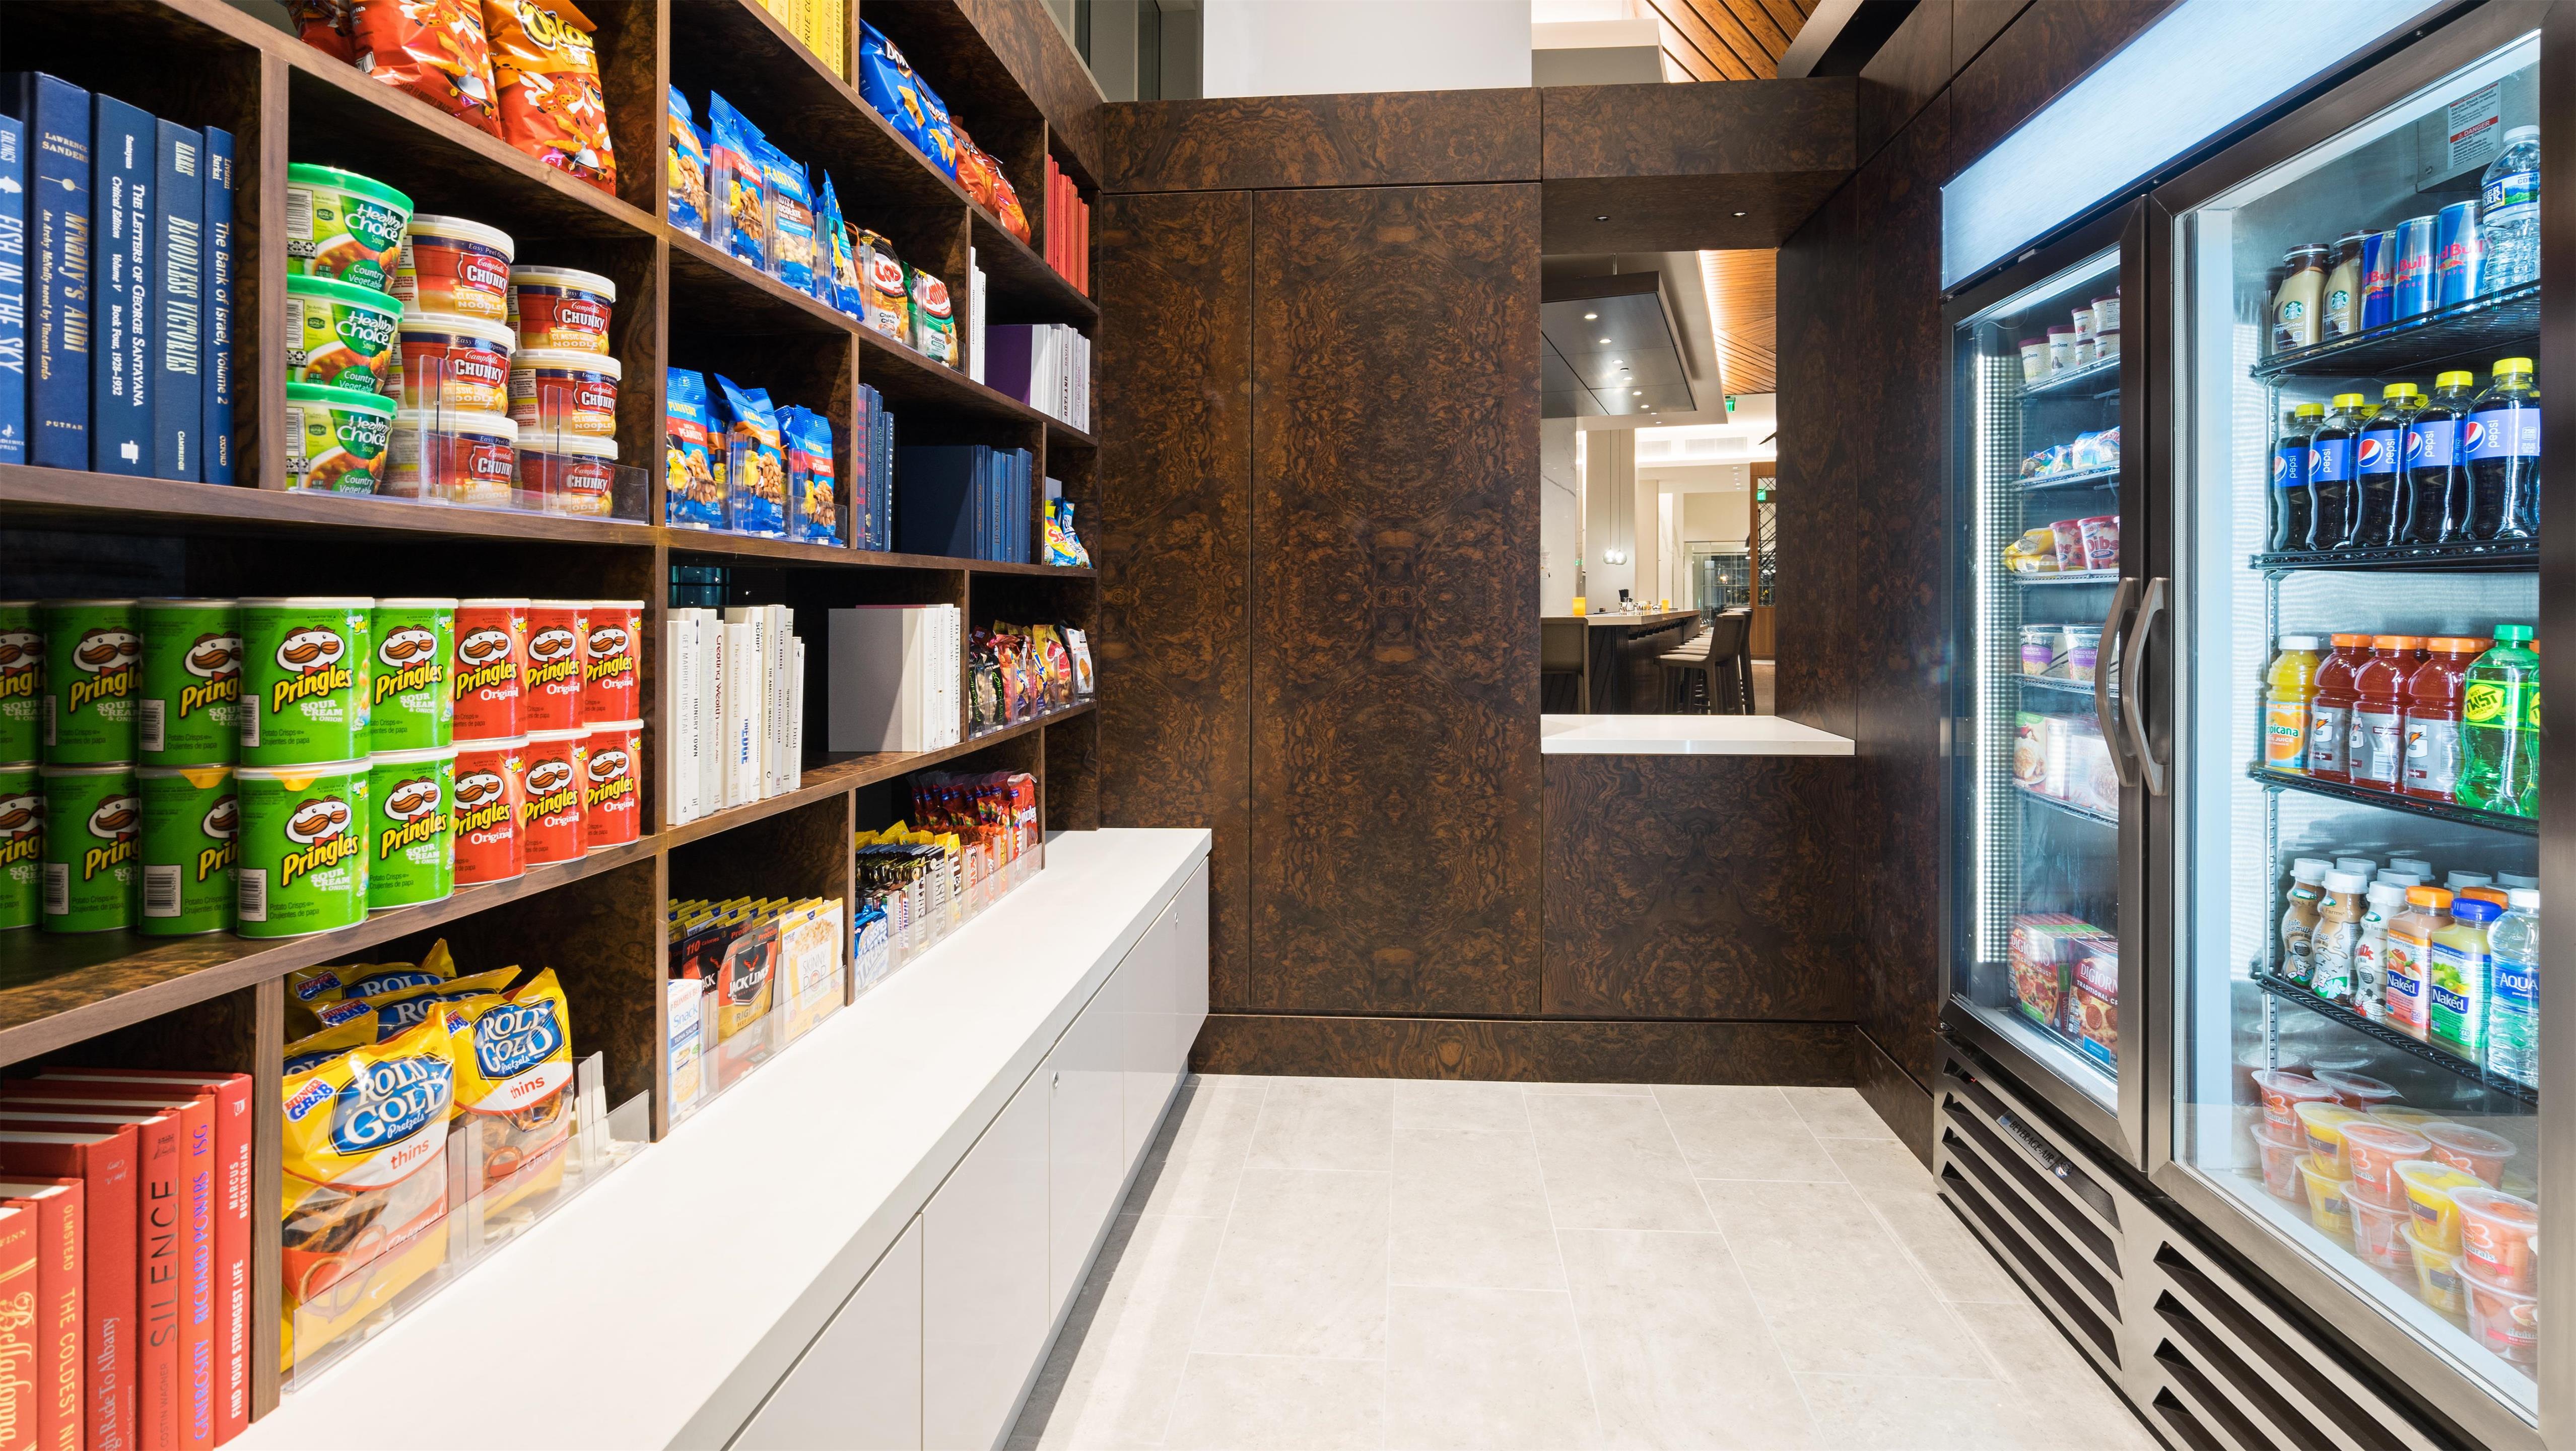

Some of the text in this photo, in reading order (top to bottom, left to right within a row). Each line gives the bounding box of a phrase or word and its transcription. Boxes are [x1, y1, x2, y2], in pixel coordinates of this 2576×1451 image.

[836, 38, 840, 46] OF
[2464, 120, 2490, 137] DANGER
[1, 130, 15, 163] ERLINGS
[42, 141, 88, 163] SANDERS
[45, 132, 87, 152] LAWRENCE
[124, 135, 134, 169] Santayana
[175, 141, 195, 177] HARRIS
[112, 176, 122, 209] Critical
[43, 209, 53, 222] An
[112, 209, 122, 238] Edition
[345, 213, 398, 242] Choice
[357, 204, 403, 230] Healthy
[40, 224, 53, 248] Archy
[371, 235, 384, 247] Soup
[468, 243, 484, 252] Easy
[2450, 240, 2483, 257] Bull
[112, 253, 122, 283] Volume
[354, 265, 384, 281] Country
[2399, 253, 2427, 272] Bull
[349, 274, 382, 290] Vegetable
[466, 265, 508, 293] CHUNKY
[0, 215, 23, 374] FISH IN THE SKY
[42, 284, 52, 309] novel
[132, 185, 145, 407] THE LETTERS OF GEORGE SANTAYANA
[166, 215, 198, 375] BLOODLESS VICTORIES
[40, 309, 52, 324] by
[112, 304, 122, 326] Book
[213, 222, 229, 405] The Bank of Israel, Volume 2
[348, 311, 394, 334] Healthy
[562, 309, 604, 331] CHUNKY
[41, 323, 51, 353] Vincent
[64, 305, 87, 353] Alibi
[111, 328, 122, 350] Four,
[336, 321, 388, 346] Choice
[456, 337, 473, 346] Easy
[41, 355, 52, 380] Lardo
[344, 371, 375, 385] Country
[454, 359, 504, 384] CHUNKY
[581, 392, 615, 412] CHUNKY
[678, 426, 703, 442] PEANUTS
[2424, 430, 2434, 458] pepsi
[2488, 419, 2499, 448] pepsi
[2323, 448, 2332, 473] pepsi
[2386, 438, 2396, 465] pepsi
[812, 461, 831, 474] PEANUTS
[2289, 454, 2298, 479] pepsi
[566, 474, 608, 492] CHUNKY
[456, 659, 517, 700] Pringles
[528, 657, 580, 687] Pringles
[586, 653, 633, 681] Pringles
[273, 665, 353, 713] Pringles
[375, 661, 443, 704] Pringles
[480, 687, 519, 701] Original
[301, 700, 336, 713] SOUR
[303, 708, 343, 716] CREAM
[2465, 690, 2497, 712] TWIST
[588, 775, 634, 805] Pringles
[525, 788, 578, 821] Pringles
[454, 802, 510, 836] Pringles
[381, 812, 447, 859] Pringles
[470, 828, 514, 844] Original
[282, 833, 358, 887] Pringles
[311, 868, 345, 881] SOUR
[313, 876, 350, 887] CREAM
[758, 929, 778, 941] Protein
[686, 942, 700, 956] 110
[2037, 967, 2052, 977] CRUST
[2080, 964, 2118, 993] DIGIORN
[2388, 974, 2416, 994] Naked
[728, 976, 751, 998] JACK
[2077, 980, 2109, 1001] TRADITIONAL
[320, 1000, 366, 1021] HUNGER
[2432, 988, 2465, 1012] Naked
[324, 1003, 373, 1028] GRAB
[482, 1007, 550, 1041] ROLD
[673, 1003, 698, 1028] Snack
[686, 1023, 698, 1035] SALAD
[284, 1079, 323, 1110] HUNGER
[351, 1059, 428, 1108] ROLD
[510, 1076, 546, 1099] thins
[289, 1083, 333, 1120] GRAB
[344, 1078, 448, 1144] GOLD
[387, 1111, 425, 1139] Pretzels
[391, 1139, 429, 1170] thins
[2009, 1120, 2054, 1164] BEVERAGE-AIR
[229, 1162, 239, 1210] MARCUS
[239, 1143, 248, 1219] BUCKINGHAM
[193, 1171, 209, 1243] POWERS
[63, 1204, 74, 1271] OLMSTEAD
[150, 1177, 178, 1347] SILENCE
[193, 1244, 209, 1325] RICHARD
[231, 1260, 243, 1419] FIND YOUR STRONGEST LIFE
[59, 1287, 76, 1419] THE COLDEST
[98, 1317, 120, 1434] Ride To Albany
[194, 1339, 209, 1440] GENEROSITY
[160, 1363, 169, 1447] COSTIN WAGNER
